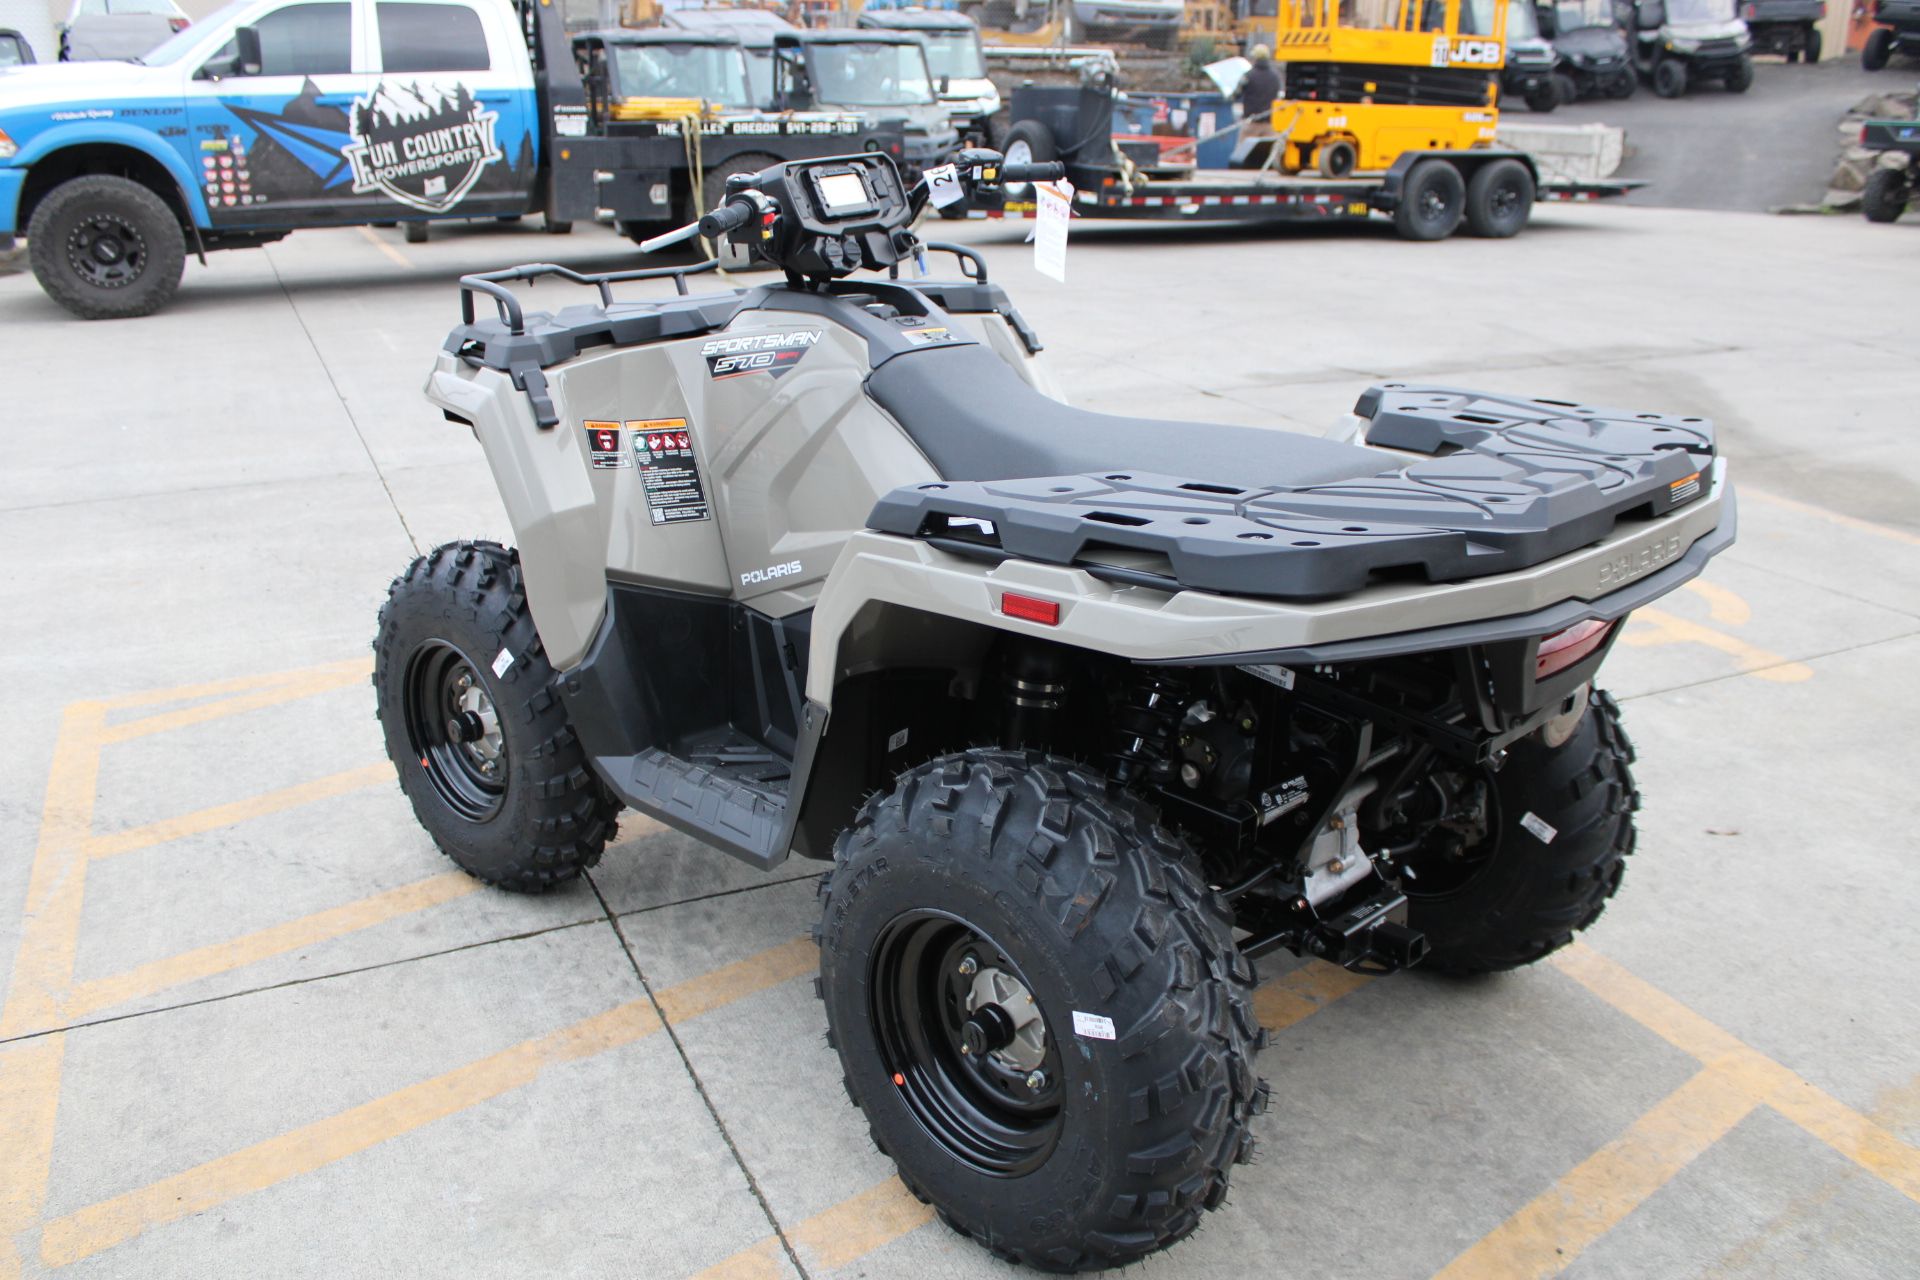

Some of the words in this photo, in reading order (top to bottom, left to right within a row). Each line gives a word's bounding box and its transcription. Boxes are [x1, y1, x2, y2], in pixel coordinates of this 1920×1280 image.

[1450, 41, 1500, 63] JCB
[121, 108, 183, 117] DUNLOP
[656, 123, 679, 136] THE
[733, 121, 780, 135] OREGON
[351, 140, 399, 185] FUN
[402, 118, 492, 160] COUNTRY
[375, 146, 482, 180] POWERSPORTS
[700, 330, 823, 356] SPORTSMAN
[714, 351, 776, 373] 570
[741, 560, 802, 586] POLARIS
[1596, 531, 1681, 590] POLARIS
